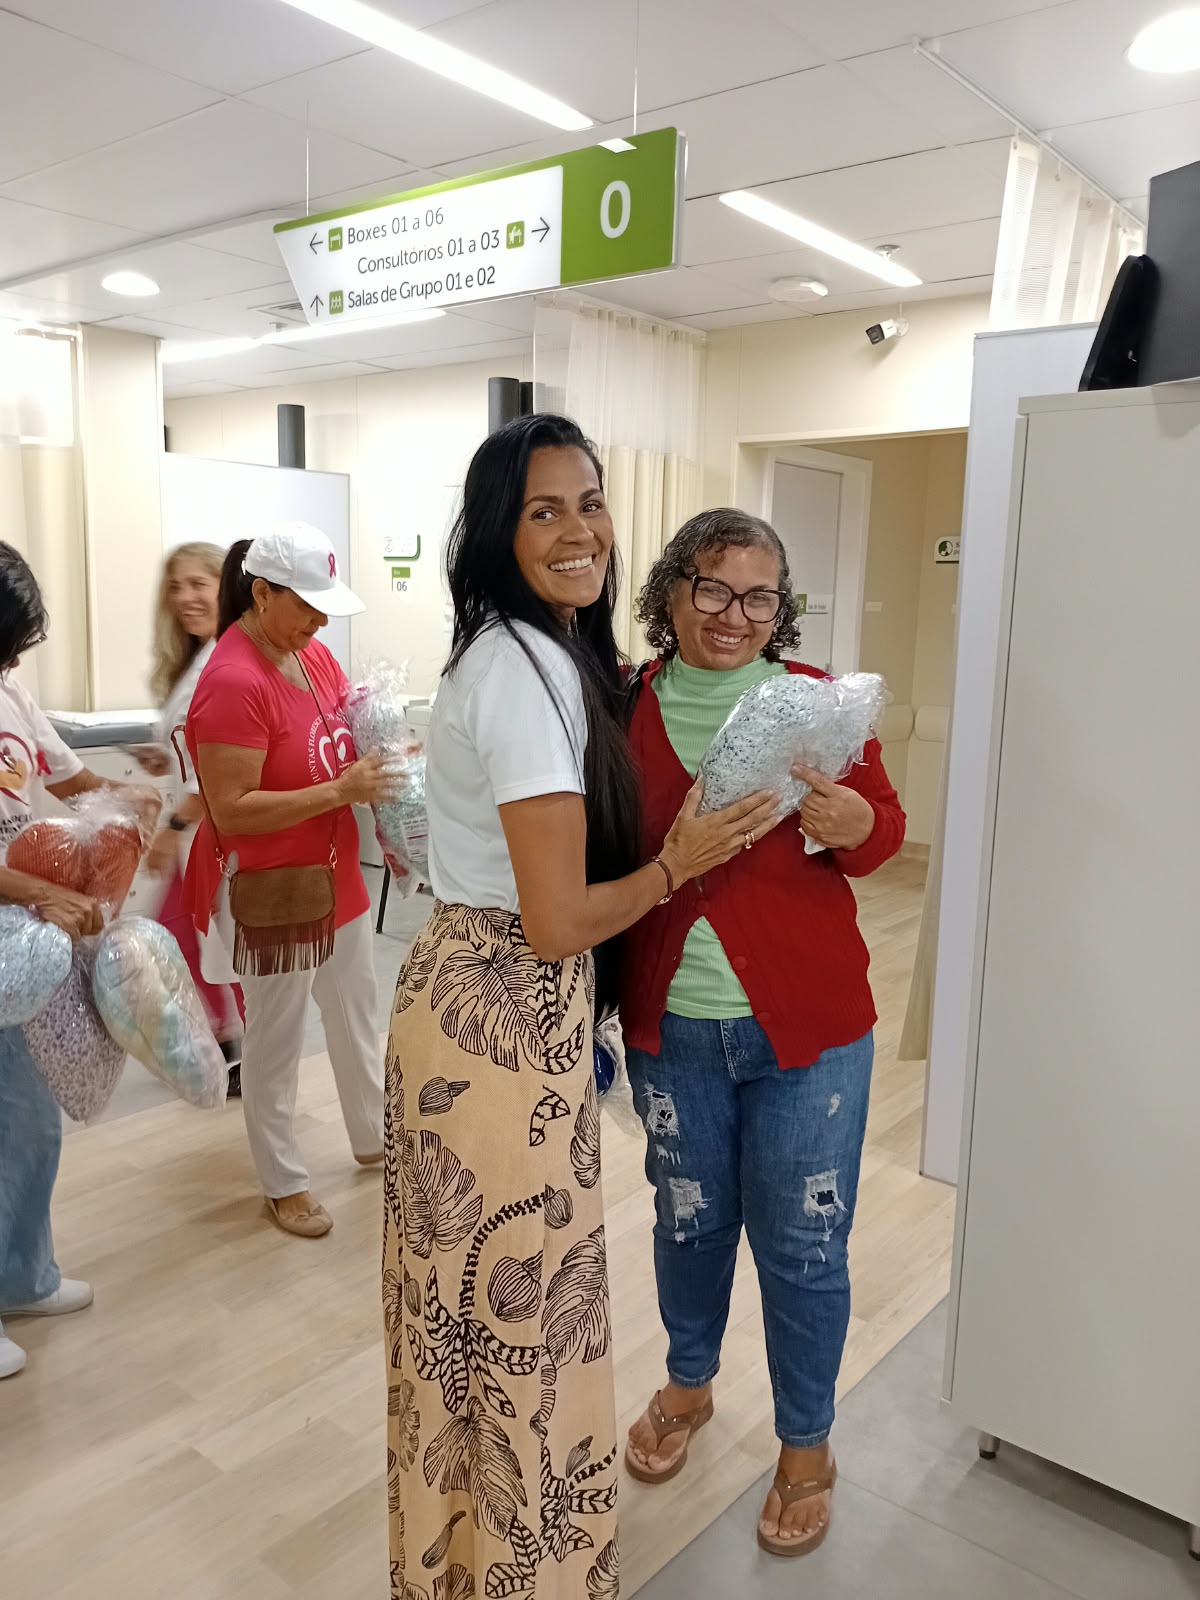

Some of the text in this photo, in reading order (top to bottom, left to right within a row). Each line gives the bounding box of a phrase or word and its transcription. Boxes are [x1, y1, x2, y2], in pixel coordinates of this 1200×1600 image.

[348, 207, 444, 245] Boxes 01 a 06
[600, 180, 631, 239] 0
[357, 229, 500, 274] Consultórios 01 a 03
[348, 265, 496, 309] Salas de Grupo 01 e 02
[396, 581, 408, 592] 06
